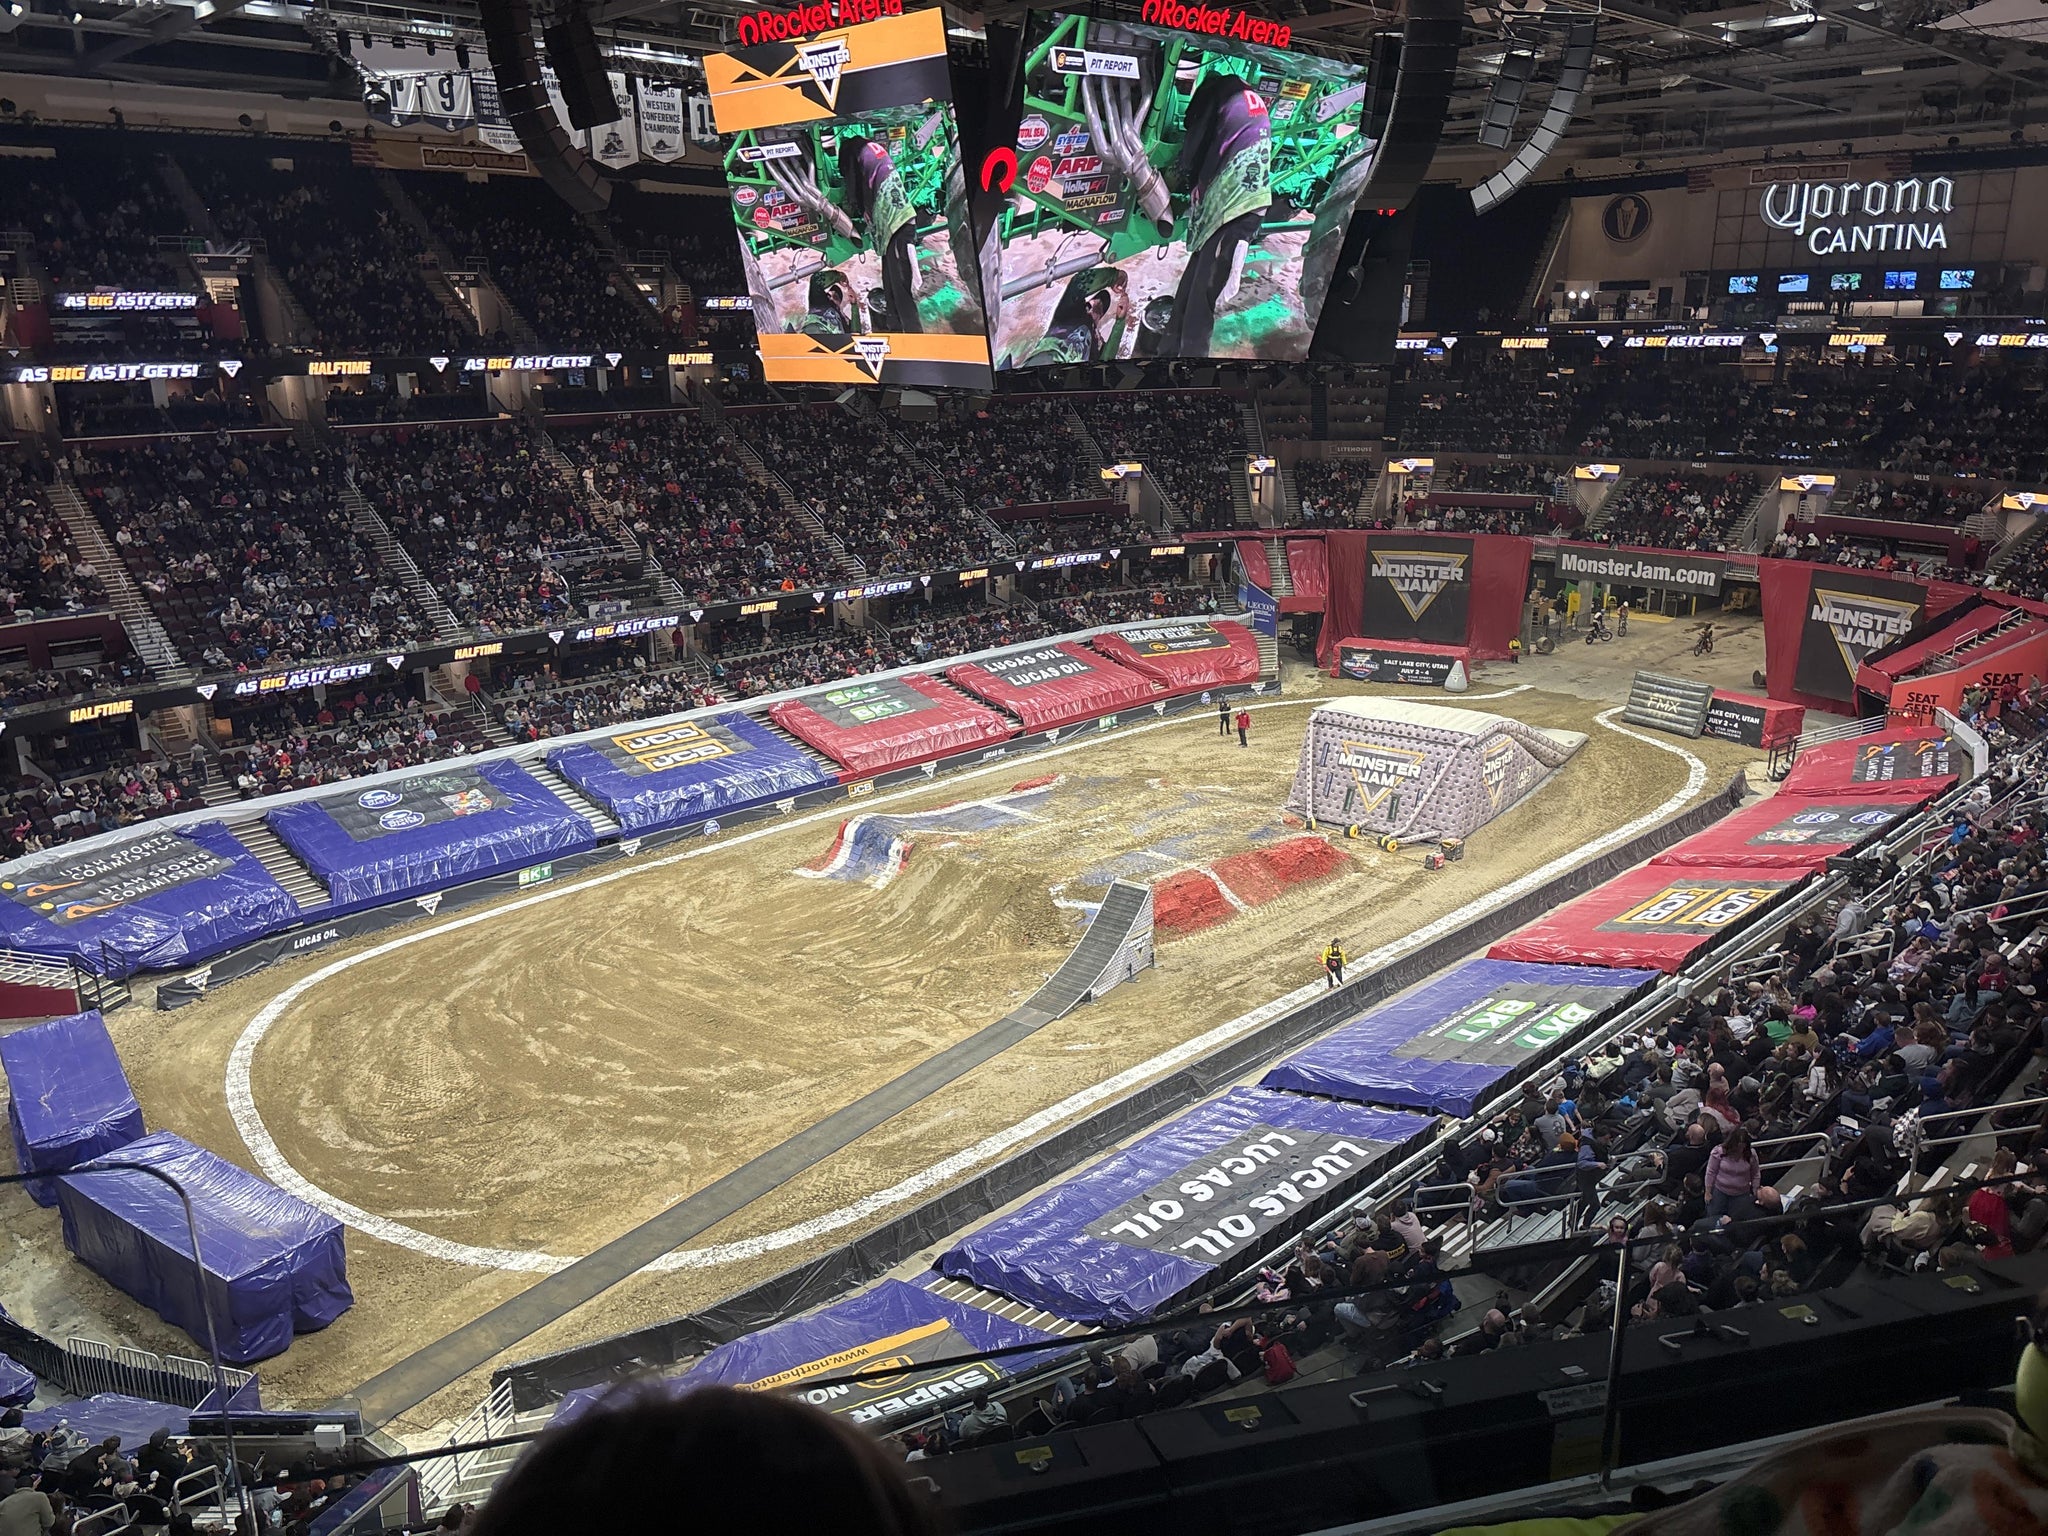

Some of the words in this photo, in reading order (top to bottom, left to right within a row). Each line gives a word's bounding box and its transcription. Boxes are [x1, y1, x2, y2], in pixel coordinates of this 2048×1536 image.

[758, 1, 836, 42] Rocket
[839, 0, 902, 26] Arena
[1160, 0, 1230, 36] Rocket
[1229, 10, 1291, 48] Arena
[799, 49, 850, 71] MONSTER
[1090, 58, 1102, 68] PIT
[1104, 60, 1133, 72] REPORT
[815, 65, 840, 81] JAM
[645, 100, 676, 112] WESTERN
[642, 112, 681, 124] CONFERENCE
[644, 124, 680, 135] CHAMPIONS
[1033, 127, 1045, 138] SEAL
[1057, 135, 1089, 145] SYSTEM
[775, 146, 794, 154] REPORT
[1033, 165, 1049, 175] NGK
[1056, 157, 1102, 175] ARP
[1064, 180, 1090, 194] Holley
[772, 203, 800, 217] ARP
[1065, 194, 1116, 209] MAGNAFLOW
[1760, 177, 1955, 235] Corona
[1809, 223, 1948, 255] CANTINA
[64, 296, 86, 307] AS
[87, 295, 114, 306] BIG
[117, 295, 137, 306] AS
[138, 295, 155, 306] IT
[154, 295, 197, 306] GETS!
[706, 298, 719, 308] AS
[719, 298, 734, 307] BIG
[735, 298, 747, 307] AS
[1501, 337, 1550, 349] HALFTIME
[1624, 336, 1644, 347] AS
[1645, 336, 1668, 347] BIG
[1667, 336, 1687, 347] AS
[1686, 336, 1702, 347] IT
[1702, 335, 1744, 347] GETS!
[1828, 333, 1887, 346] HALFTIME
[1975, 334, 1999, 346] AS
[1999, 334, 2026, 346] BIG
[2026, 334, 2048, 346] AS
[854, 344, 890, 353] MONSTER
[866, 352, 884, 362] JAM
[464, 358, 486, 371] AS
[487, 357, 513, 370] BIG
[513, 357, 533, 369] AS
[534, 356, 550, 368] IT
[551, 355, 592, 368] GETS!
[668, 353, 713, 365] HALFTIME
[19, 367, 48, 382] AS
[51, 366, 86, 381] BIG
[89, 366, 117, 380] AS
[118, 365, 141, 379] IT
[143, 364, 201, 378] GETS!
[308, 361, 372, 376] HALFTIME
[1151, 546, 1185, 557] HALFTIME
[1032, 559, 1043, 569] AS
[1042, 558, 1055, 567] BIG
[1056, 557, 1068, 567] AS
[1067, 556, 1076, 565] IT
[1076, 553, 1101, 564] GETS!
[959, 568, 989, 581] HALFTIME
[1371, 563, 1464, 582] MONSTER
[1561, 554, 1717, 586] MonsterJam.com
[833, 590, 847, 600] AS
[847, 588, 864, 599] BIG
[863, 586, 877, 597] AS
[875, 584, 887, 595] IT
[886, 580, 912, 593] GETS!
[1393, 579, 1439, 593] JAM
[740, 600, 779, 615] HALFTIME
[1247, 601, 1275, 611] LECOM
[576, 629, 593, 640] AS
[594, 625, 615, 637] BIG
[615, 622, 632, 634] AS
[632, 620, 646, 631] IT
[646, 615, 679, 629] GETS!
[1811, 605, 1912, 636] MONSTER
[1838, 628, 1885, 649] JAM
[454, 642, 503, 660] HALFTIME
[983, 654, 1036, 674] LUCAS
[235, 680, 257, 694] AS
[259, 676, 287, 690] BIG
[288, 672, 310, 687] AS
[310, 669, 328, 684] IT
[329, 663, 372, 681] GETS!
[1007, 669, 1060, 687] LUCAS
[1981, 672, 2023, 687] SEAT
[1648, 695, 1680, 714] FMX
[1907, 692, 1940, 703] SEAT
[70, 699, 134, 723] HALFTIME
[852, 700, 906, 719] BKT
[1724, 711, 1741, 721] CITY,
[1742, 714, 1760, 725] UTAH
[1708, 717, 1723, 726] JULY
[627, 728, 699, 749] JCB
[649, 744, 723, 768] JCB
[1338, 752, 1422, 780] MONSTER
[1357, 771, 1397, 787] JAM
[851, 784, 871, 795] JCB
[59, 858, 107, 876] UTAH
[111, 834, 172, 860] SPORTS
[98, 876, 145, 895] UTAH
[149, 852, 210, 878] SPORTS
[111, 858, 221, 902] COMMISSION
[519, 865, 551, 883] BKT
[1632, 890, 1694, 921] JCB
[1696, 891, 1760, 924] JCB
[294, 933, 321, 949] LUCAS
[323, 928, 338, 941] OIL
[1450, 1000, 1530, 1042] BKT
[1517, 1002, 1596, 1048] BKT
[1179, 1131, 1298, 1201] LUCAS
[1248, 1140, 1369, 1218] LUCAS
[848, 1370, 989, 1424] SUPER
